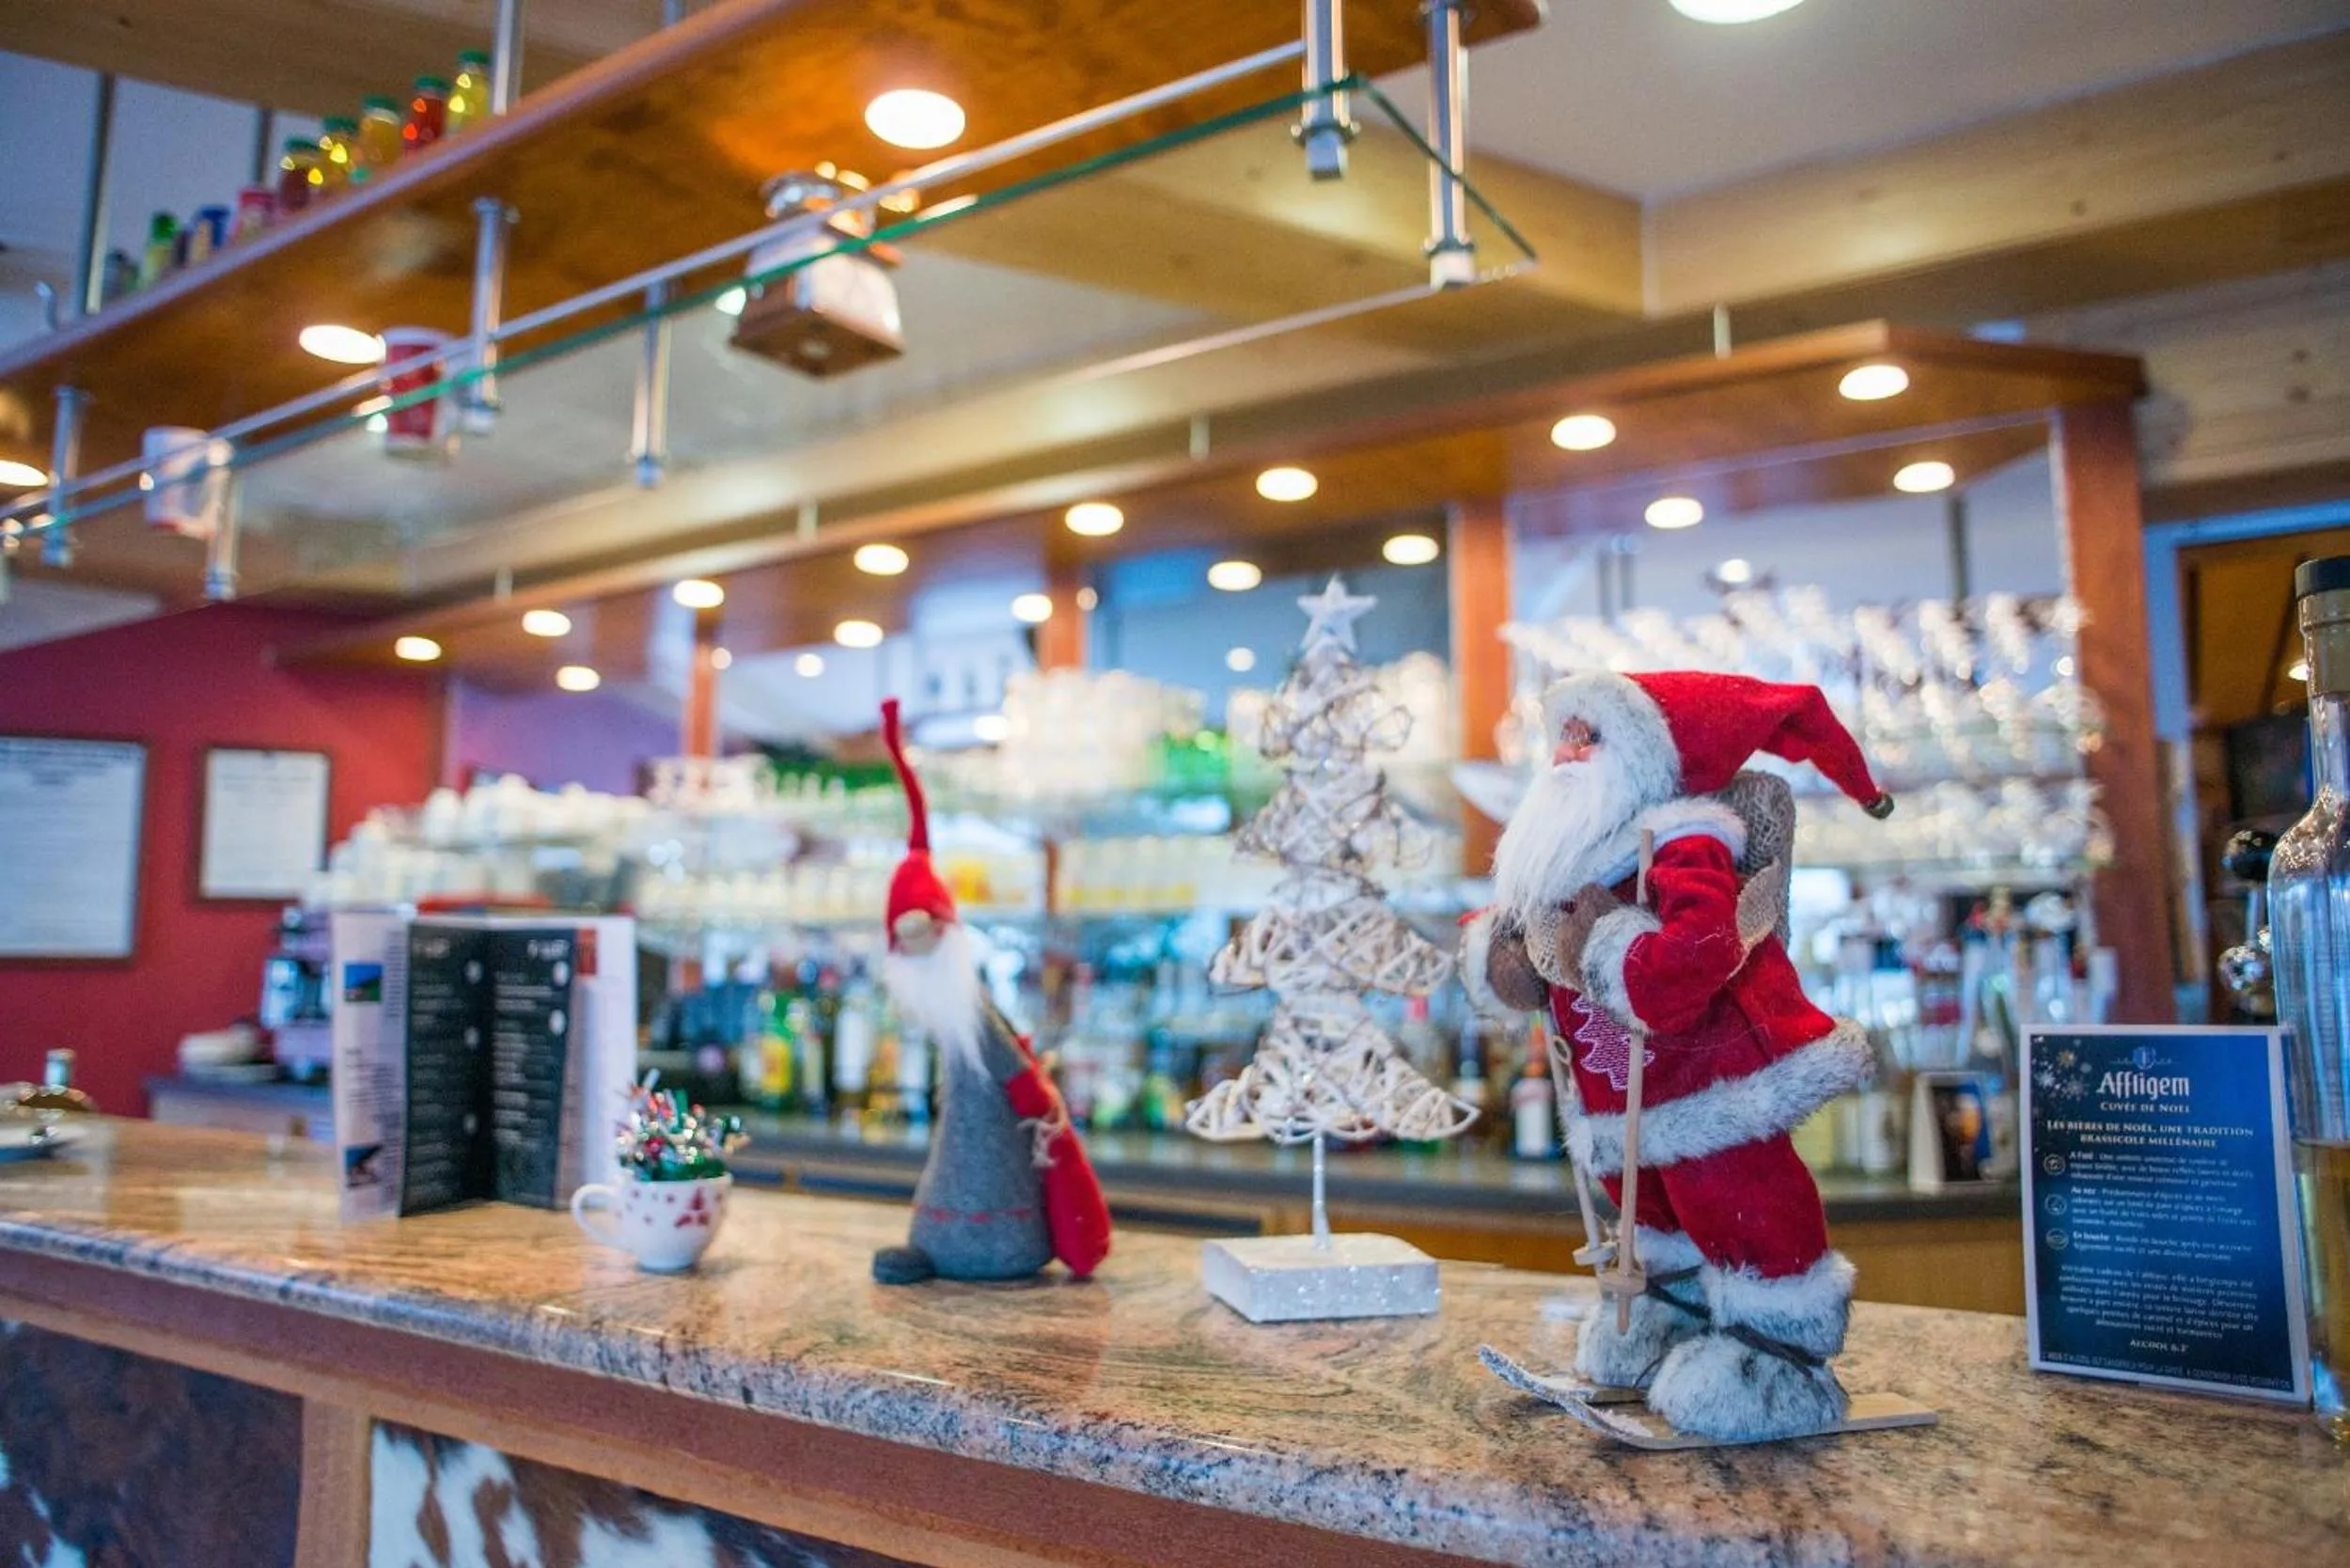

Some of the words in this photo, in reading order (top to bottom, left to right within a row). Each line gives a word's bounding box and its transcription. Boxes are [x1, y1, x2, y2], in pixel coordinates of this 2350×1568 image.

[2095, 1071, 2190, 1101] Affligem
[2139, 1103, 2155, 1113] DE
[2047, 1120, 2065, 1131] LES
[2106, 1122, 2121, 1132] DE
[2160, 1124, 2183, 1135] UNE
[2187, 1125, 2254, 1137] TRADITION
[2080, 1134, 2146, 1145] BRASSICOLE
[2129, 1339, 2169, 1352] ALCOOL
